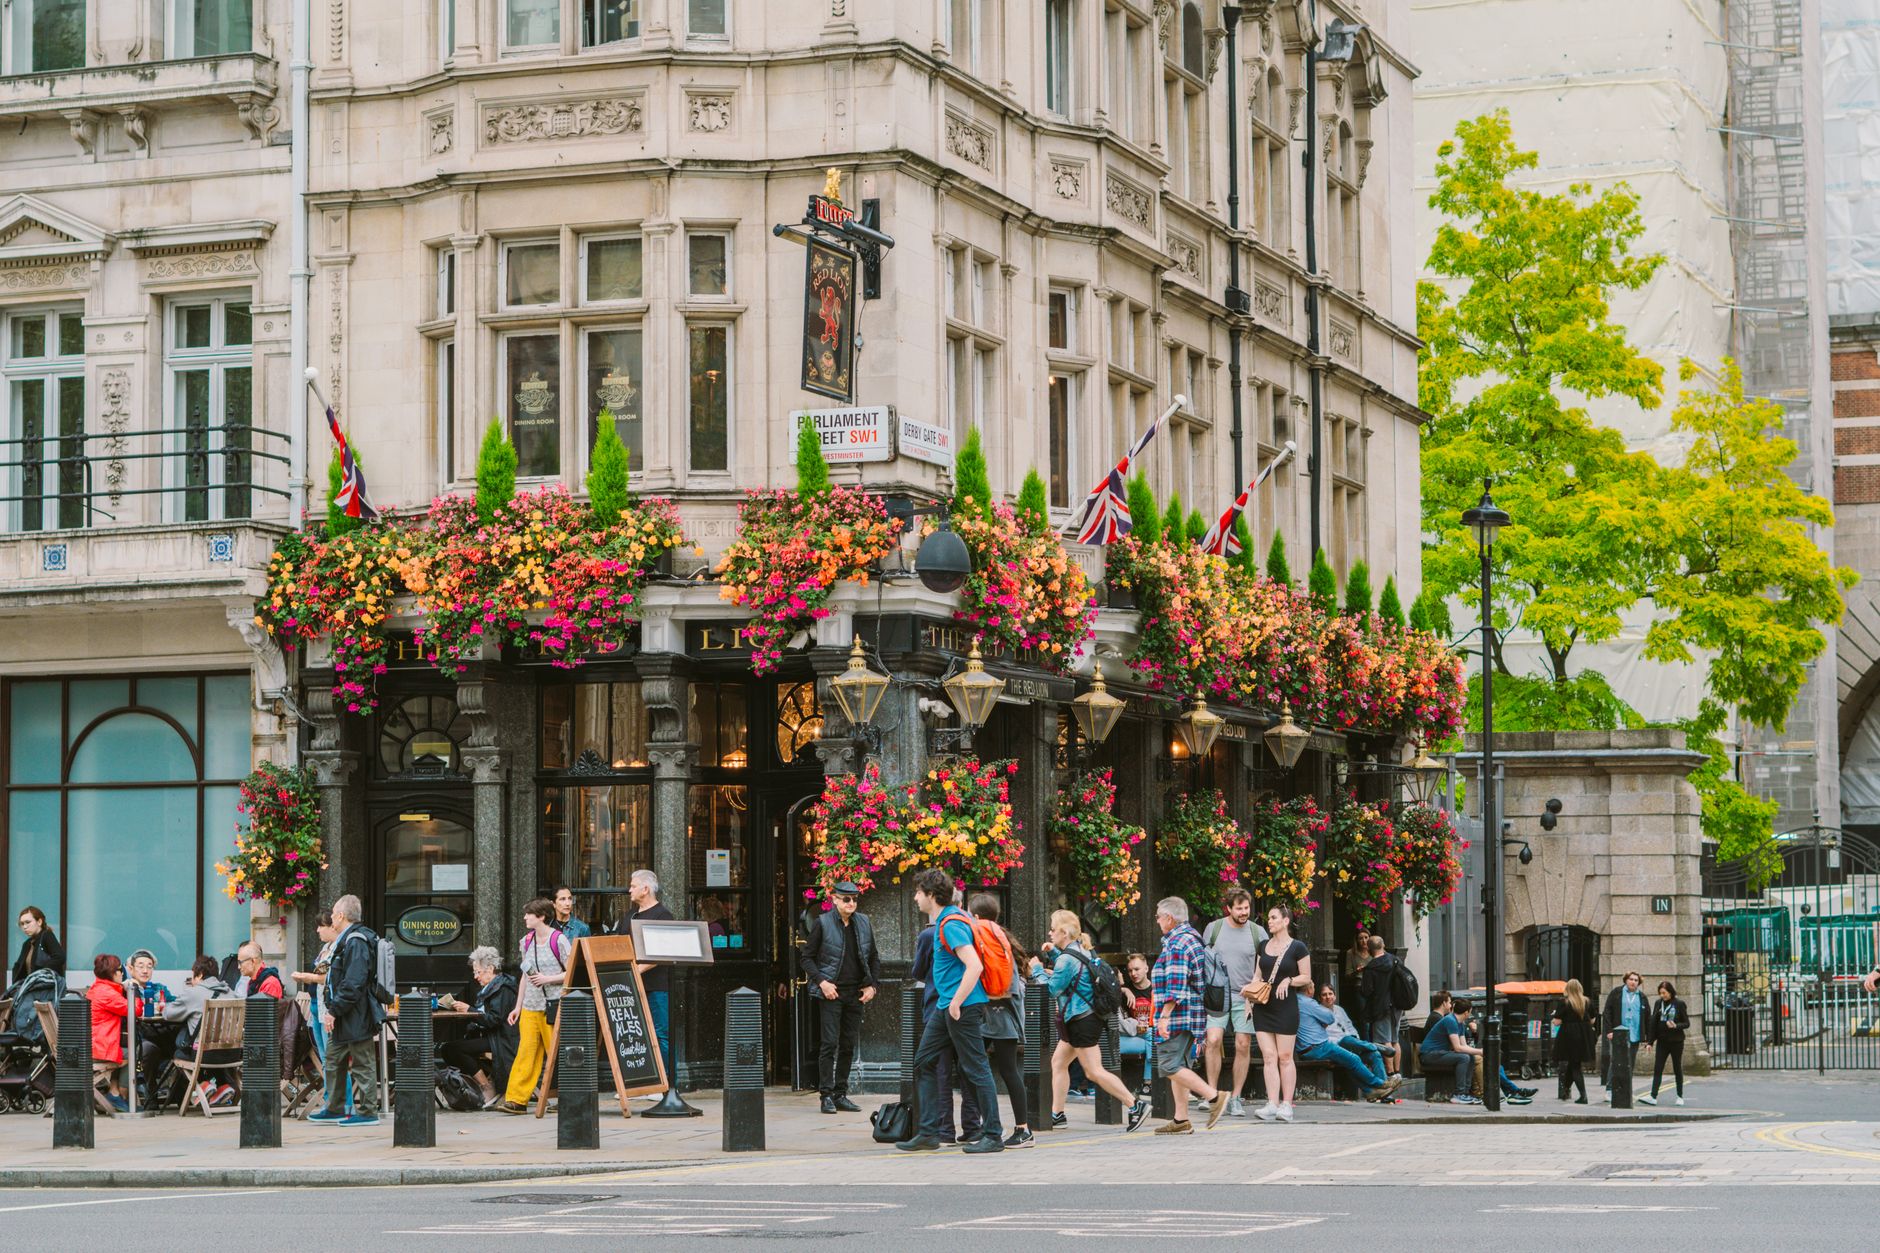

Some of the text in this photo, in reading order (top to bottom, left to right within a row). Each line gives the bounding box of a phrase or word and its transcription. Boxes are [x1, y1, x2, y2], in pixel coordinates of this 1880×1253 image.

[813, 268, 848, 301] RED LION
[850, 429, 878, 444] SW1
[904, 422, 949, 449] DERBY GATE SW1
[1010, 678, 1049, 698] THE RED LION
[1656, 899, 1668, 911] IN
[402, 920, 457, 930] DINING ROOM
[604, 983, 633, 996] TRADITIONAL
[609, 1007, 638, 1022] REAL
[615, 1020, 643, 1041] ALES
[619, 1041, 647, 1058] Guest Ales
[626, 1057, 645, 1068] ON TAP
